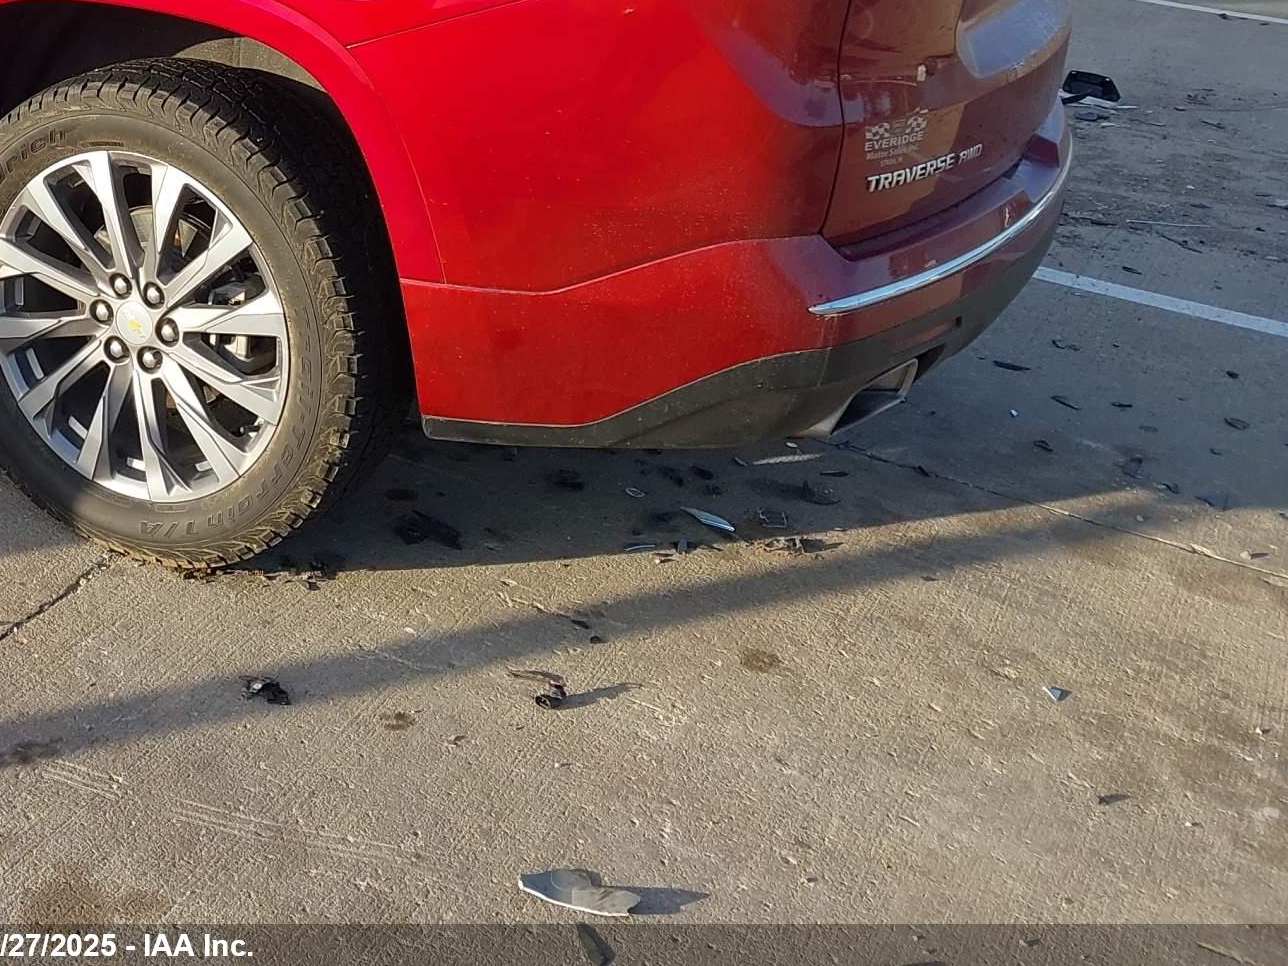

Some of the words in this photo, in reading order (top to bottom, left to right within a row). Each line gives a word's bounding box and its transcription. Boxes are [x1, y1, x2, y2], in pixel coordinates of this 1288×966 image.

[864, 131, 925, 152] EVERIDGE
[866, 153, 956, 193] TRAVERSE
[958, 143, 983, 165] AWD
